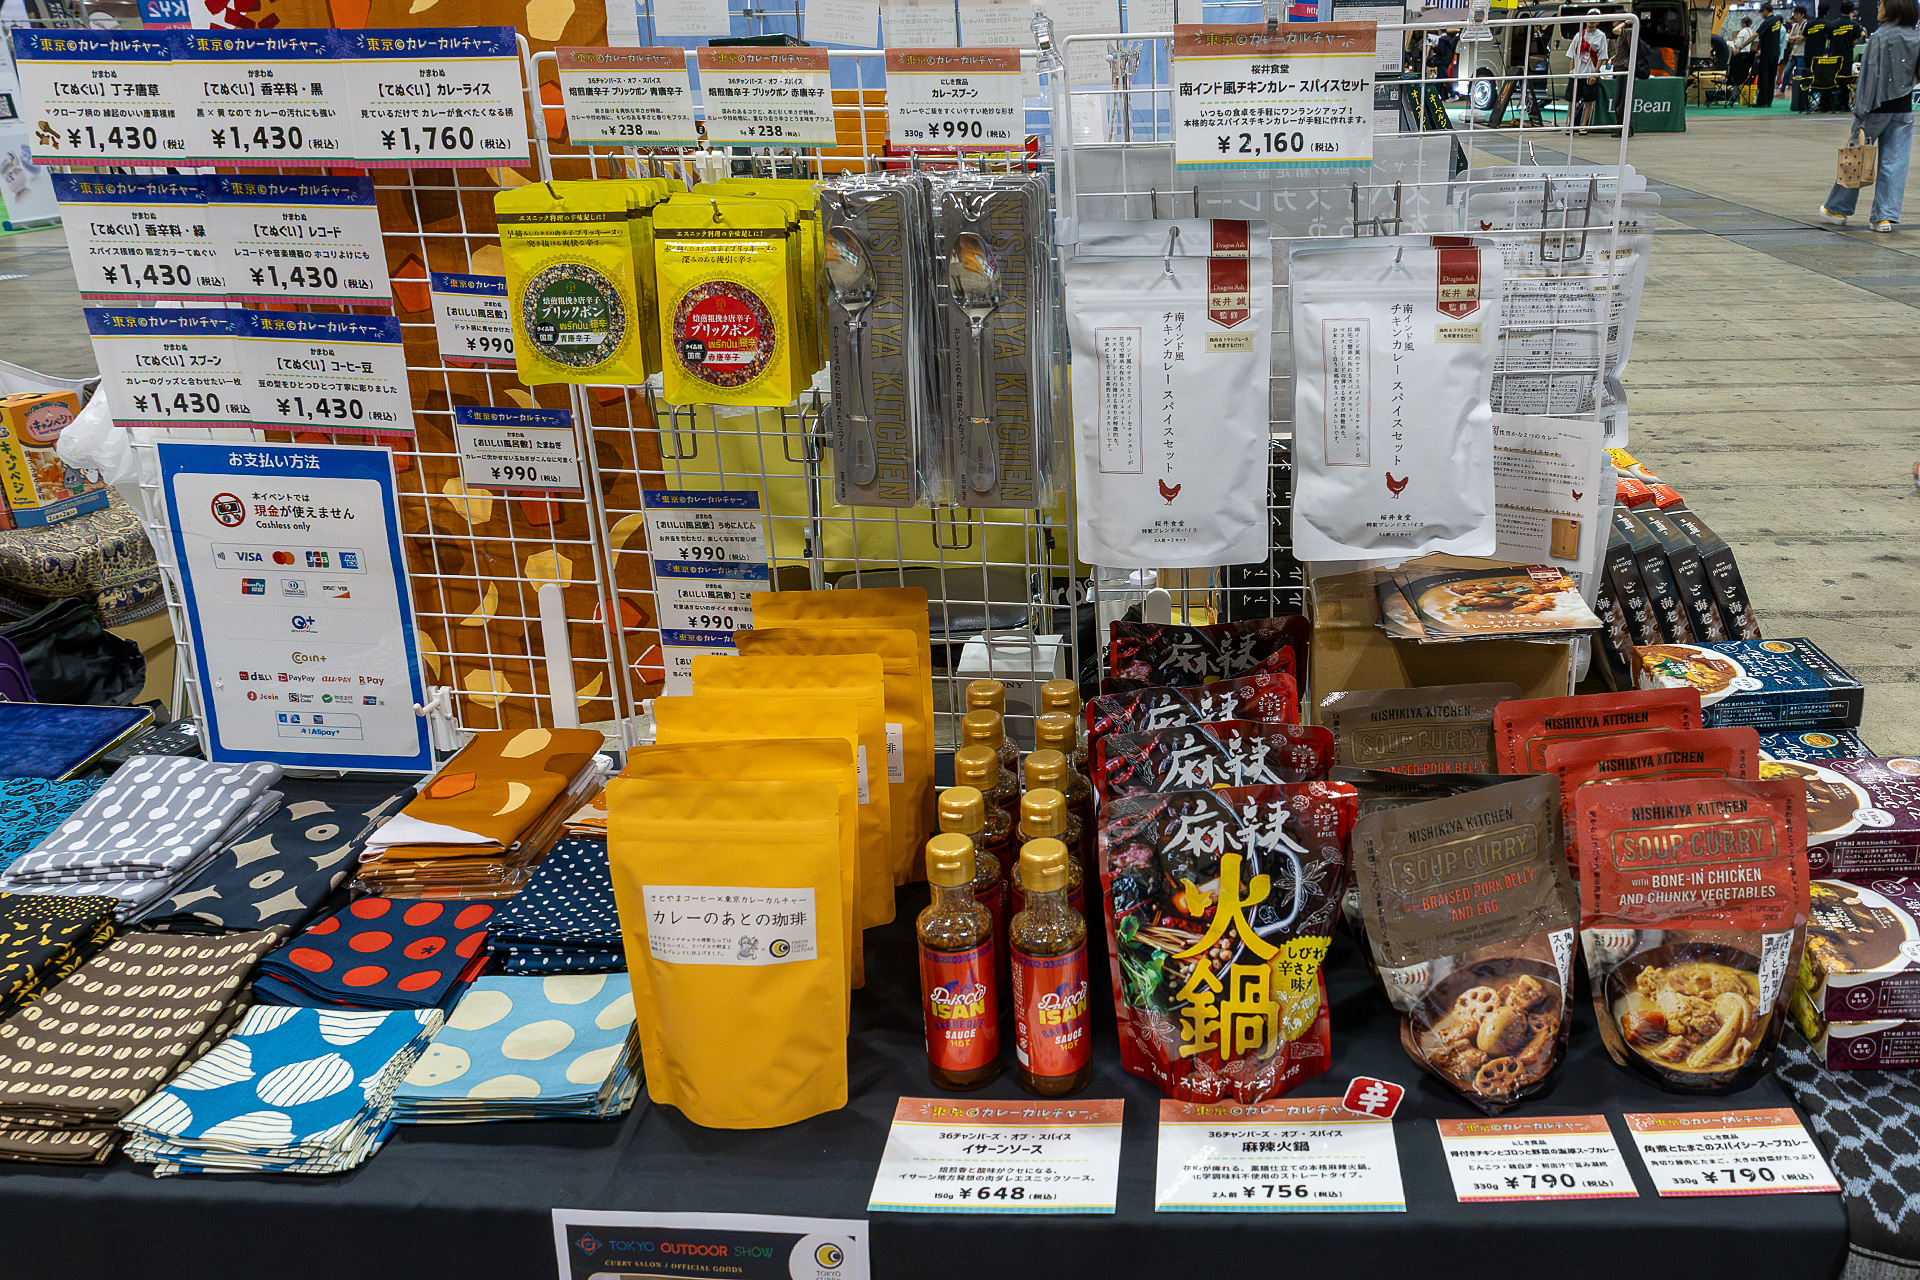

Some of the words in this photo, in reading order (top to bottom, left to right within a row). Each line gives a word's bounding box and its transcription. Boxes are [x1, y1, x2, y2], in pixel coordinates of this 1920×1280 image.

[92, 70, 118, 78] かまわぬ
[248, 69, 274, 78] かまわぬ
[419, 69, 446, 77] かまわぬ
[1251, 64, 1290, 74] 桜井食堂
[931, 89, 979, 98] カレースプーン
[1179, 80, 1296, 96] 南インド風チキンカレー
[1299, 78, 1369, 93] スパイスセット
[255, 108, 336, 118] カレーの汚れにも強い
[361, 109, 419, 118] 見ているだけで
[421, 108, 514, 117] カレーが食べたくなる柄
[1200, 107, 1354, 117] いつもの食卓を手軽にワンランクアップ!
[1183, 116, 1367, 127] 本格的なスパイスチキンカレーが手軽に作れます。
[608, 124, 643, 136] ¥238
[748, 125, 783, 137] ¥238
[904, 129, 923, 138] 330g
[928, 121, 983, 138] ¥990
[986, 130, 1011, 139] (税込)
[67, 126, 157, 152] ¥1,430
[211, 126, 303, 153] ¥1,430
[308, 139, 339, 150] (税込)
[381, 126, 475, 154] ¥1,760
[480, 139, 511, 150] (税込)
[1310, 142, 1340, 152] (税込)
[131, 212, 157, 220] かまわぬ
[282, 213, 307, 221] かまわぬ
[314, 250, 370, 260] ホコリよけにも
[102, 264, 192, 288] ¥1,430
[196, 276, 227, 287] (税込)
[250, 265, 338, 291] ¥1,430
[343, 279, 374, 289] (税込)
[866, 200, 903, 359] NISHIKIYA
[989, 199, 1027, 361] NISHIKIYA
[1213, 284, 1233, 292] Dragon
[1219, 311, 1239, 320] 監修
[1448, 303, 1468, 312] 監修
[692, 314, 752, 323] 焙煎粗挽き唐辛子
[1403, 304, 1414, 352] 南インド風
[1174, 311, 1185, 362] 南インド風
[163, 343, 189, 351] かまわぬ
[310, 348, 335, 356] かまわぬ
[466, 337, 514, 353] ¥990
[1162, 311, 1174, 384] チキンカレー
[708, 353, 740, 361] 赤唐辛子
[126, 377, 242, 386] カレーのグッズと合わせたい一枚
[133, 393, 220, 416] ¥1,430
[276, 396, 364, 421] ¥1,430
[368, 411, 397, 422] (税込)
[872, 372, 910, 501] KITCHEN
[995, 372, 1033, 501] KITCHEN
[228, 452, 321, 470] お支払い方法
[491, 466, 537, 481] ¥990
[252, 492, 310, 502] 本イベントでは
[253, 504, 355, 520] 現金が使えません
[256, 520, 291, 530] Cashless
[292, 522, 311, 532] only
[234, 551, 263, 562] VISA
[679, 547, 725, 560] ¥990
[688, 615, 734, 629] ¥990
[1158, 631, 1262, 675] 麻辣
[1371, 708, 1422, 722] NISHIKIYA
[1426, 705, 1471, 717] KITCHEN
[1544, 714, 1600, 730] NISHIKIYA
[1602, 711, 1649, 726] KITCHEN
[1361, 733, 1413, 756] SOUP
[1417, 729, 1480, 750] CURRY
[1157, 729, 1286, 793] 麻辣
[1423, 762, 1453, 774] PORK
[1455, 761, 1487, 773] BELLY
[1598, 756, 1654, 773] NISHIKIYA
[1657, 751, 1704, 765] KITCHEN
[1632, 805, 1692, 821] NISHIKIYA
[1697, 800, 1748, 815] KITCHEN
[1163, 796, 1310, 860] 麻辣
[1408, 820, 1463, 844] NISHIKIYA
[1466, 807, 1513, 829] KITCHEN
[1623, 834, 1684, 861] SOUP
[1690, 828, 1763, 855] CURRY
[1403, 851, 1457, 886] SOUP
[1463, 833, 1527, 870] CURRY
[1631, 878, 1649, 886] WITH
[1652, 872, 1704, 888] BONE-IN
[1708, 868, 1762, 884] CHICKEN
[1422, 887, 1470, 911] BRAISED
[1474, 877, 1503, 898] PORK
[1505, 868, 1534, 890] BELLY
[1619, 891, 1644, 906] AND
[1647, 889, 1697, 904] CHUNKY
[1701, 885, 1776, 901] VEGETABLES
[651, 894, 807, 904] さとやまコーヒー×東京カレーカルチャー
[653, 910, 807, 927] カレーのあとの珈琲
[1451, 904, 1475, 923] AND
[1477, 899, 1499, 915] EGG
[1172, 852, 1281, 1061] 火鍋
[930, 982, 987, 1005] Disco
[1037, 981, 1088, 1011] Disco
[932, 999, 985, 1020] ISAN
[1039, 999, 1088, 1026] ISAN
[935, 1018, 985, 1031] BARBEQUE
[945, 1029, 976, 1040] SAUCE
[1054, 1028, 1083, 1045] SAUCE
[950, 1040, 971, 1048] HOT
[1060, 1040, 1078, 1052] HOT
[1358, 1082, 1389, 1114] 辛
[962, 1145, 1043, 1155] イサーンソース
[1242, 1141, 1310, 1152] 麻辣火鍋
[1644, 1140, 1809, 1153] 角煮とたまごのスパイシースープカレー
[899, 1173, 1095, 1182] イサーン地方発想の肉ダレエスニックソース。
[939, 1166, 1057, 1175] 焙煎香と酸味がクセになる、
[1672, 1177, 1698, 1185] 330g
[1702, 1167, 1776, 1183] ¥790
[1781, 1173, 1815, 1181] (税込)
[1504, 1173, 1576, 1189] ¥790
[934, 1192, 954, 1200] 150g
[959, 1186, 1026, 1200] ¥648
[1243, 1184, 1309, 1198] ¥756
[1313, 1190, 1343, 1198] (税込)
[609, 1240, 655, 1252] TOKYO
[661, 1243, 728, 1257] OUTDOOR
[734, 1246, 774, 1259] SHOW
[671, 1262, 711, 1271] OFFICIAL
[713, 1264, 743, 1273] GOODS
